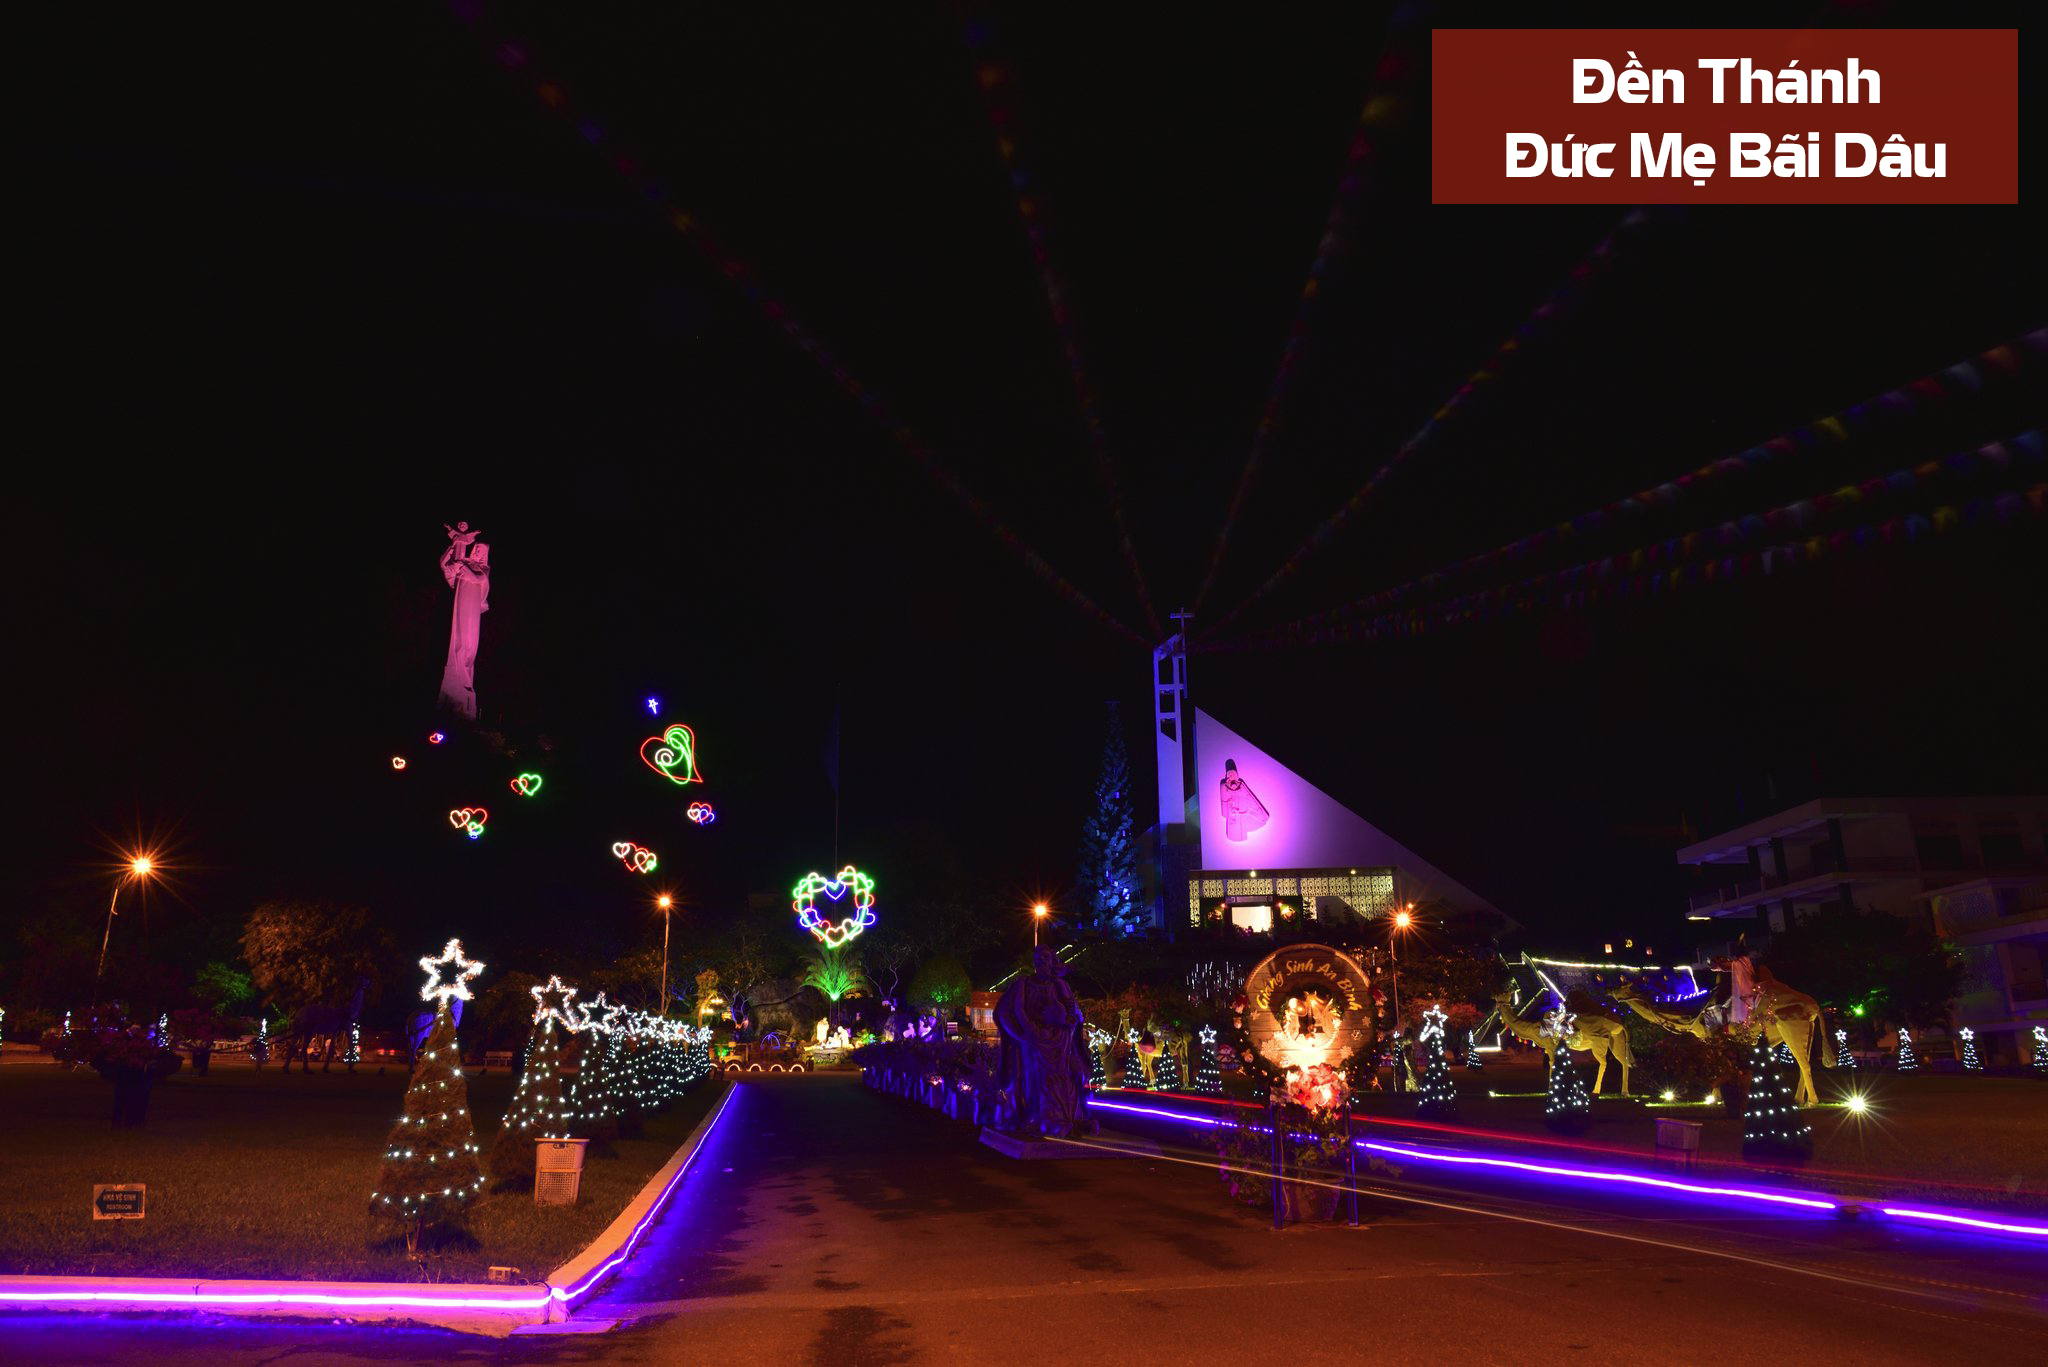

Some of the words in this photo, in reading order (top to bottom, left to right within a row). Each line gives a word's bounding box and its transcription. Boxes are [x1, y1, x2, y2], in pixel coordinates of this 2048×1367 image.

[1256, 971, 1284, 1009] Giáng
[1286, 958, 1314, 976] Sinh
[1316, 963, 1337, 980] An
